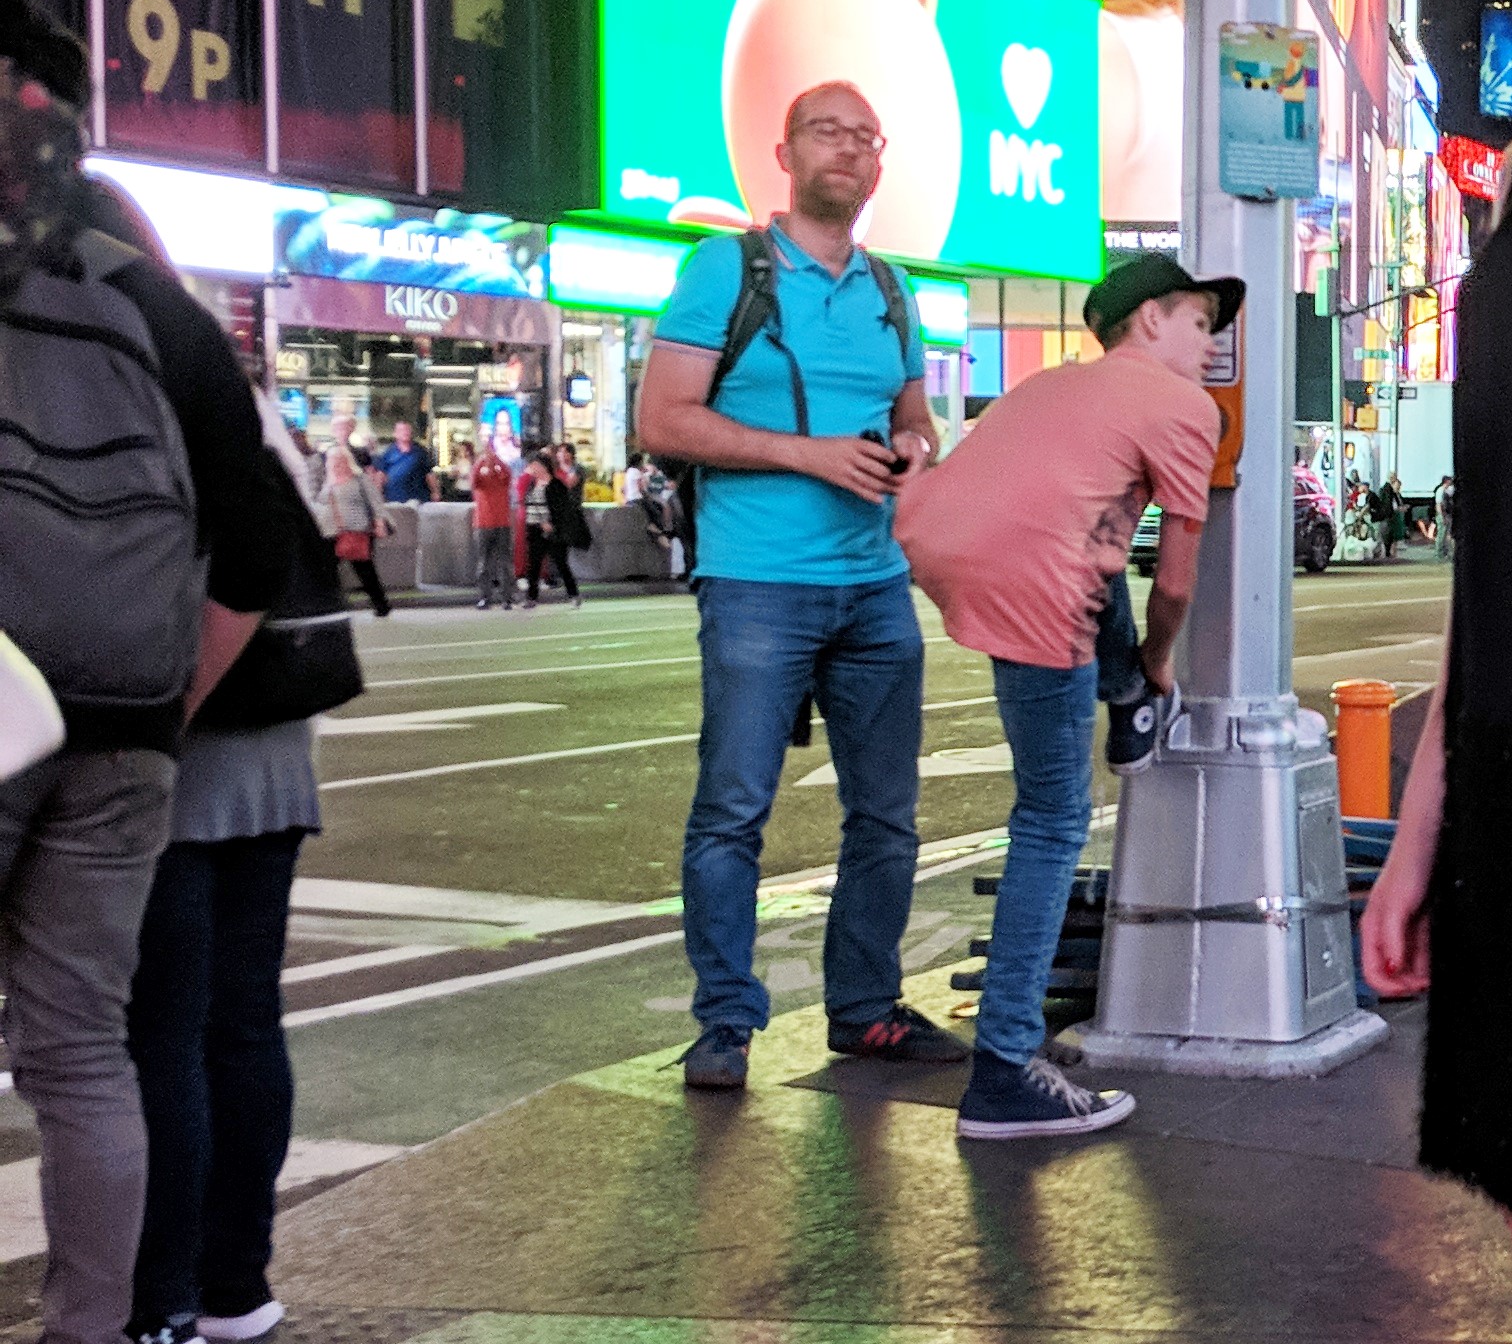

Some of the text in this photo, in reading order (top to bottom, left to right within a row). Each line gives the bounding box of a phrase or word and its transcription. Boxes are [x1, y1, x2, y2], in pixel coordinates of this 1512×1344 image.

[990, 129, 1065, 205] NYC
[1103, 230, 1138, 248] THE
[385, 285, 459, 320] KIKO
